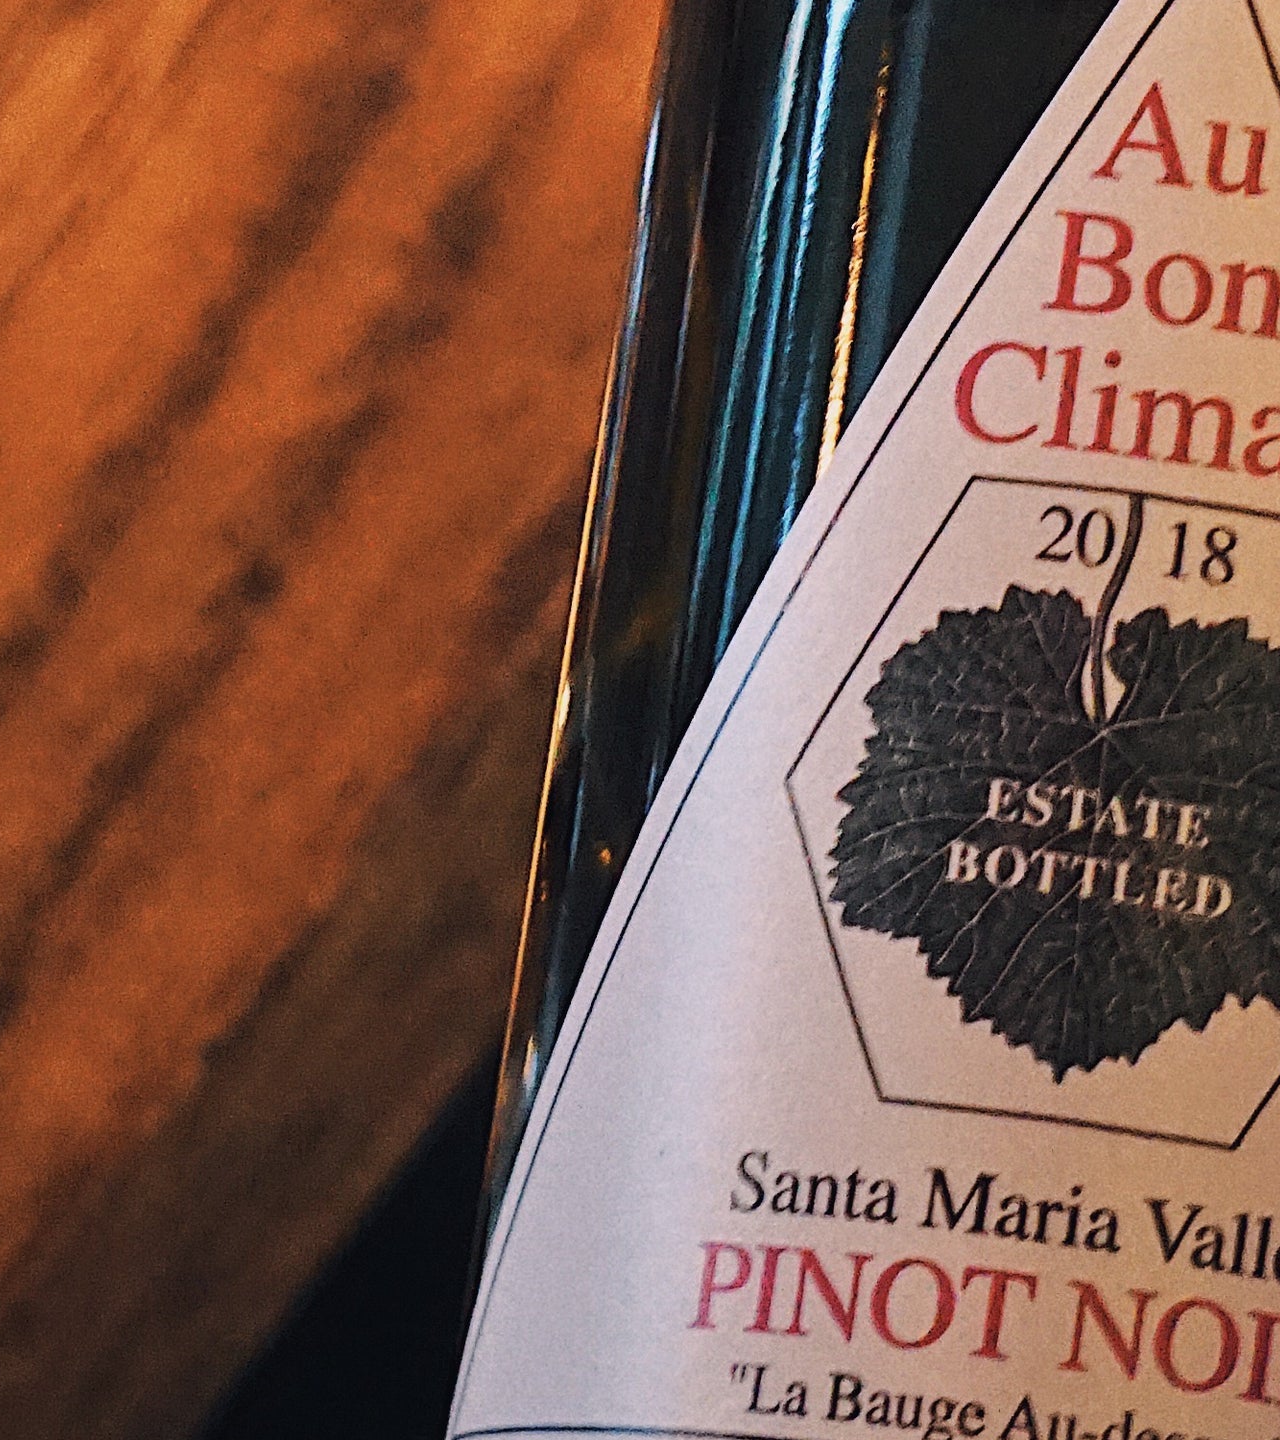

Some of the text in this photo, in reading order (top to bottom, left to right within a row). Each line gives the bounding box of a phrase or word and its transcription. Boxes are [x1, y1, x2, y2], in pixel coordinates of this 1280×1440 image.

[1093, 80, 1271, 196] Au
[1035, 505, 1238, 586] 20 18
[986, 778, 1213, 849] ESTATE
[943, 839, 1233, 918] BOTTLED
[729, 1149, 898, 1224] Santa
[919, 1166, 1121, 1254] Maria
[687, 1240, 1038, 1362] PINOT
[729, 1363, 808, 1417] "La
